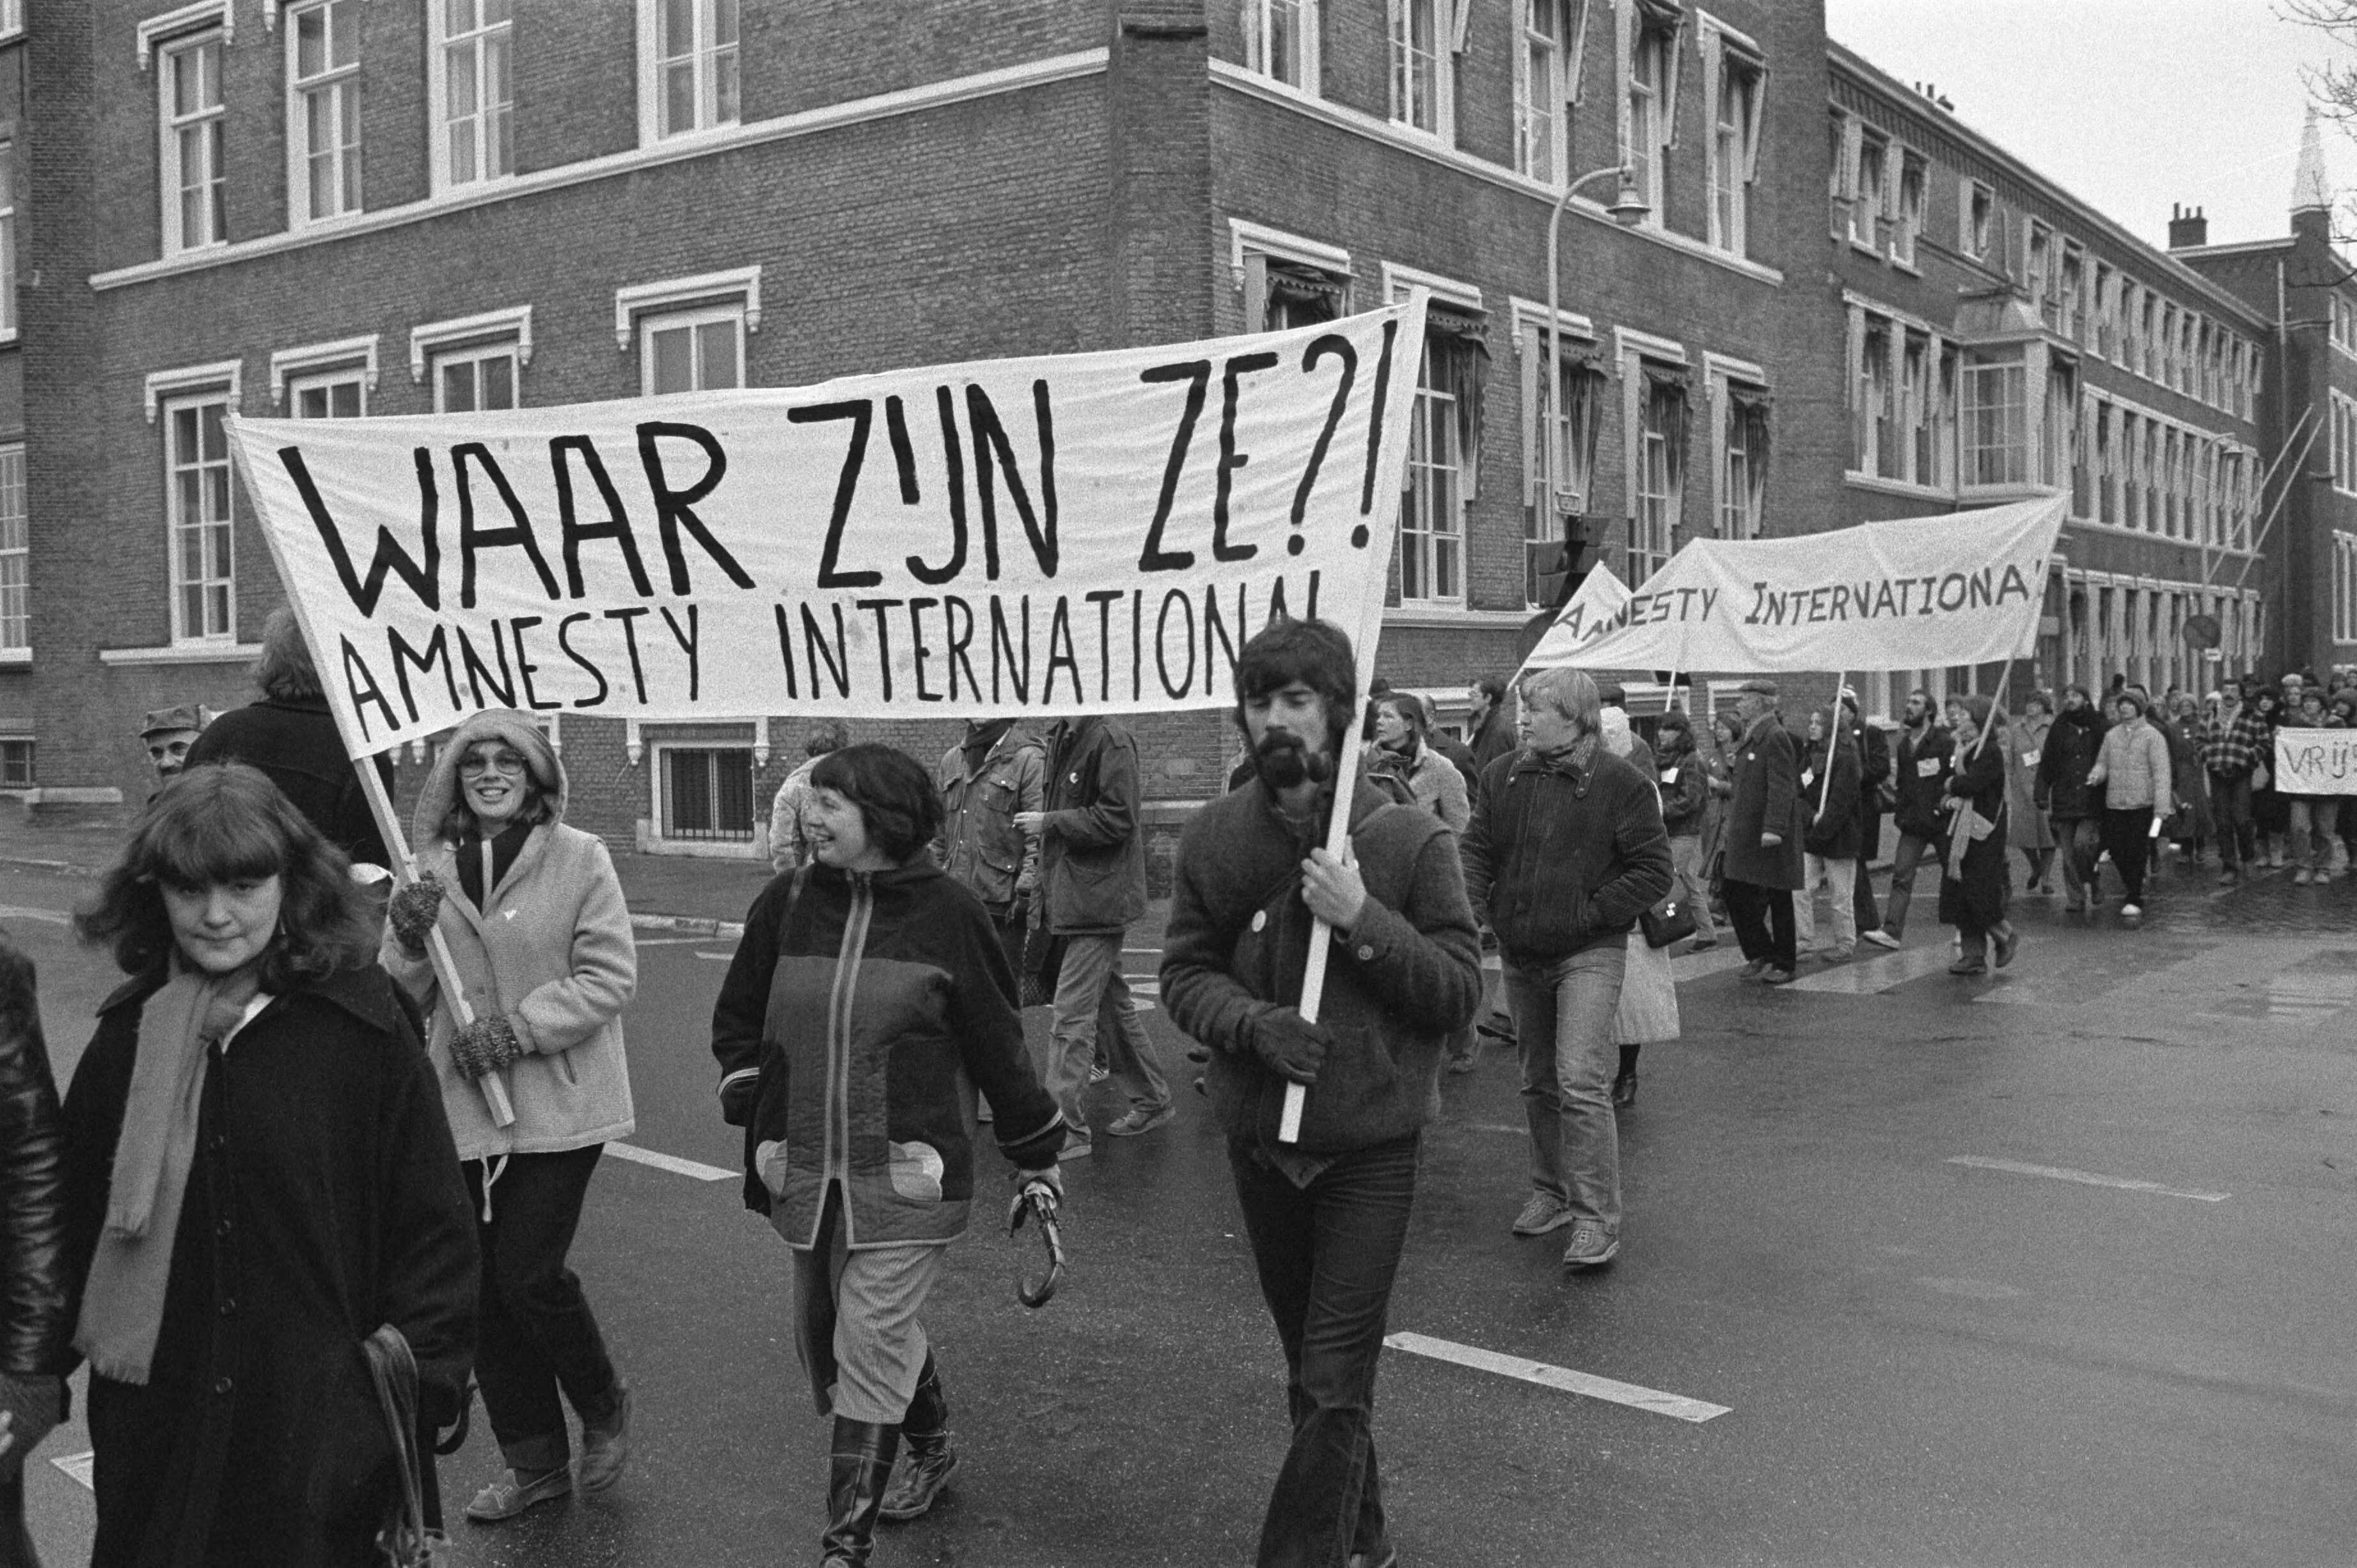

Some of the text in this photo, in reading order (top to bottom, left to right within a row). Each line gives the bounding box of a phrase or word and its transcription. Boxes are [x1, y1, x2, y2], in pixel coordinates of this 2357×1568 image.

[278, 319, 1398, 618] WAAR ZIJN ZE?!
[1744, 559, 2044, 625] INTERNATIONA
[340, 603, 699, 743] AMNESTY
